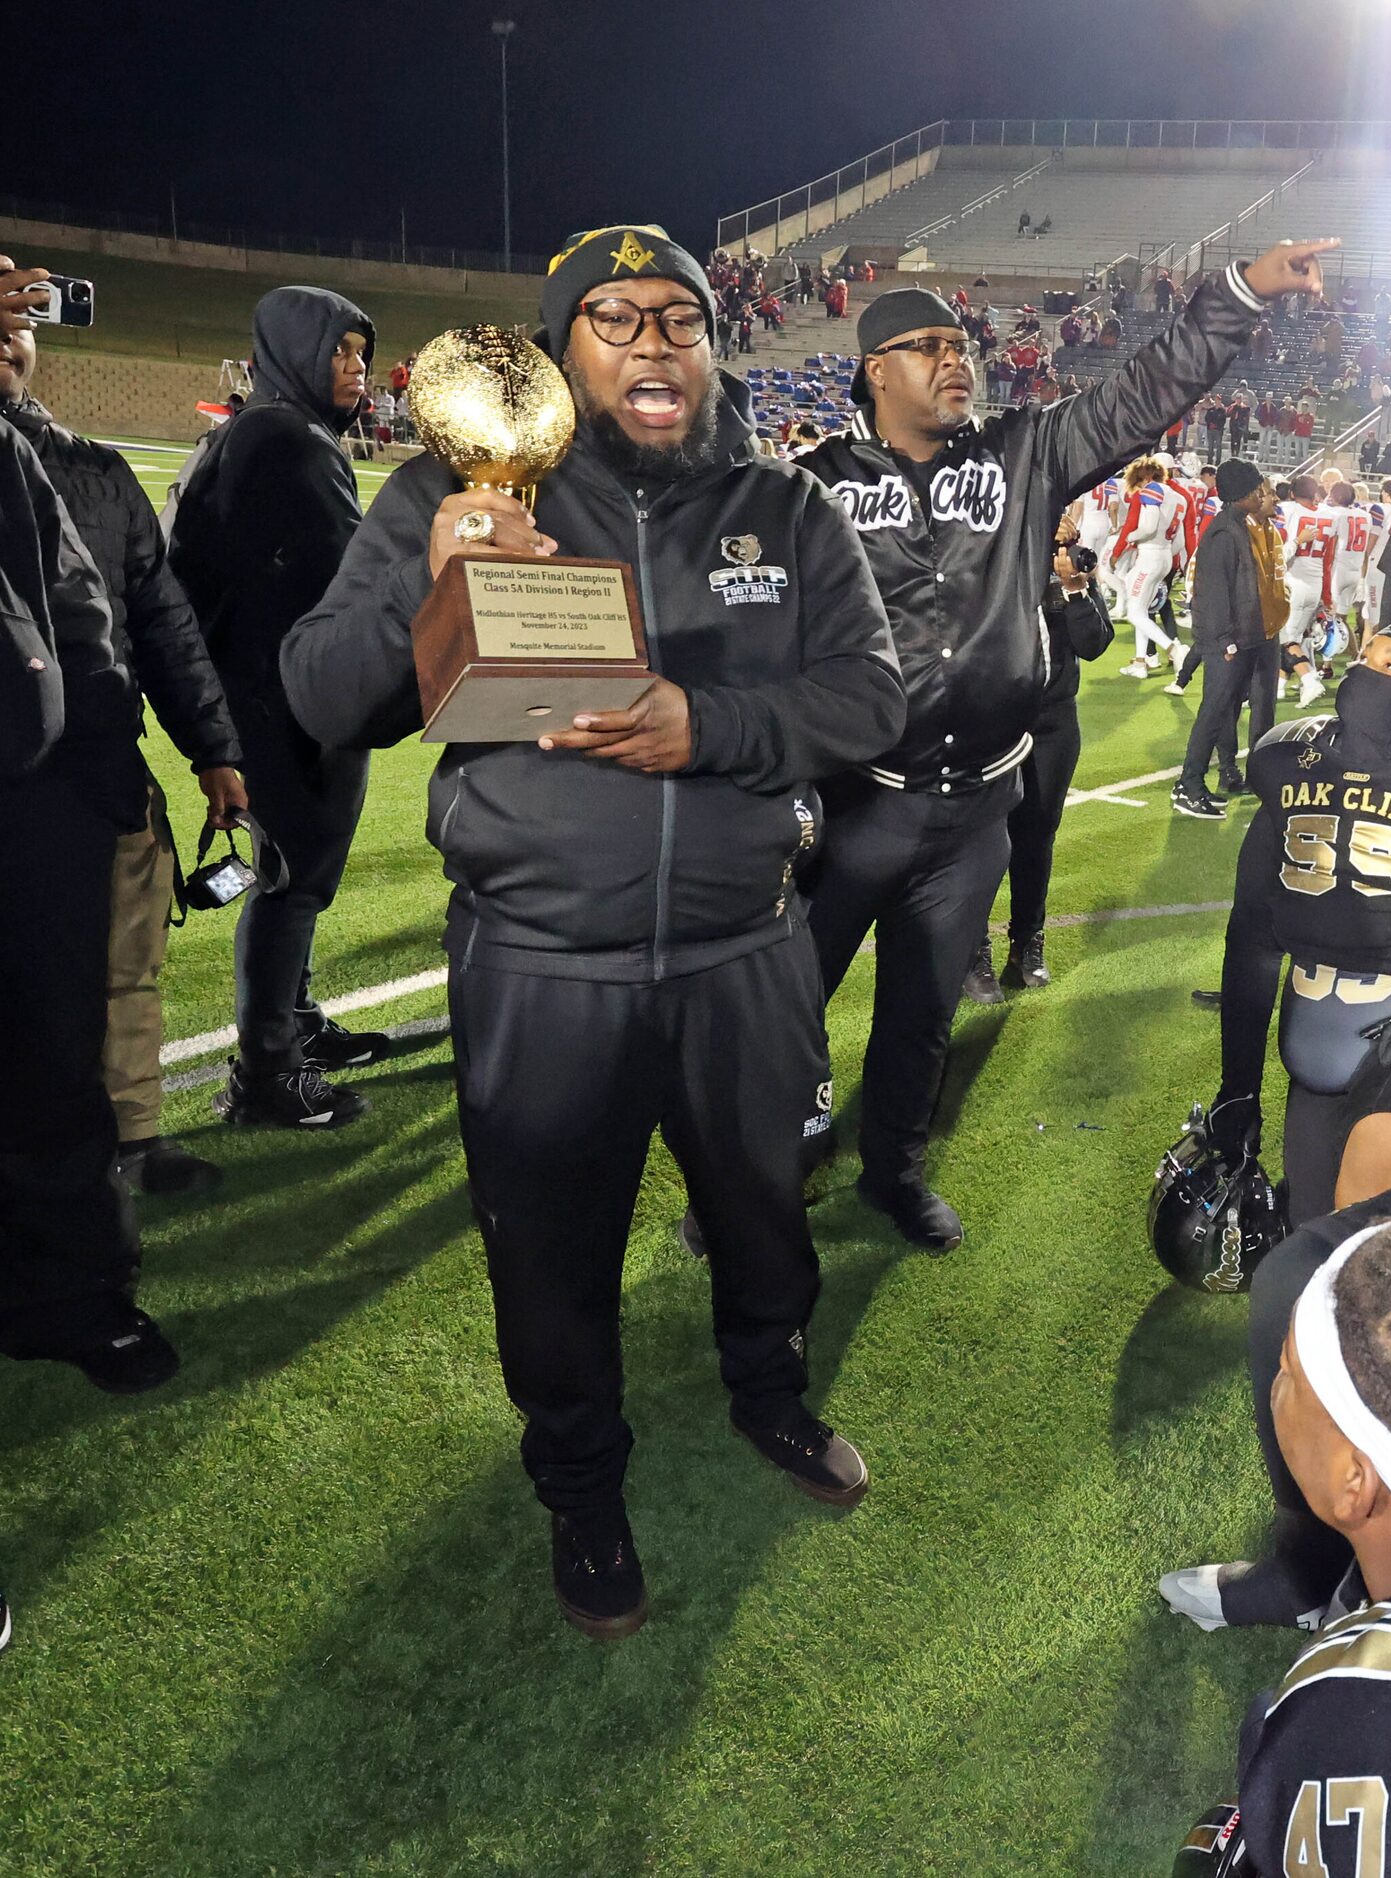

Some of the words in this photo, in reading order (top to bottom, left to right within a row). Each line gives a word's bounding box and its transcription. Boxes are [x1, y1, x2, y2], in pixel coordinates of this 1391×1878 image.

[830, 474, 914, 531] Oak
[930, 458, 1006, 532] Cliff
[1345, 516, 1368, 552] 16
[473, 568, 515, 580] Regional
[516, 570, 539, 580] Semi
[542, 571, 565, 582] Final
[567, 573, 617, 585] Champions
[484, 582, 508, 593] Class
[511, 583, 523, 593] 5A
[526, 584, 563, 595] Division
[571, 586, 601, 598] Region
[604, 587, 611, 597] II
[723, 584, 780, 598] FOOTBALL
[476, 609, 515, 619] Midlothian
[516, 610, 546, 620] Heritage
[567, 612, 586, 620] South
[588, 612, 601, 620] Oak
[602, 613, 616, 621] Cliff
[522, 622, 557, 630] November
[558, 622, 570, 631] 24,
[510, 642, 542, 651] Mesquite
[544, 642, 576, 650] Memorial
[1281, 782, 1334, 808] OAK
[1283, 1775, 1389, 1878] 47
